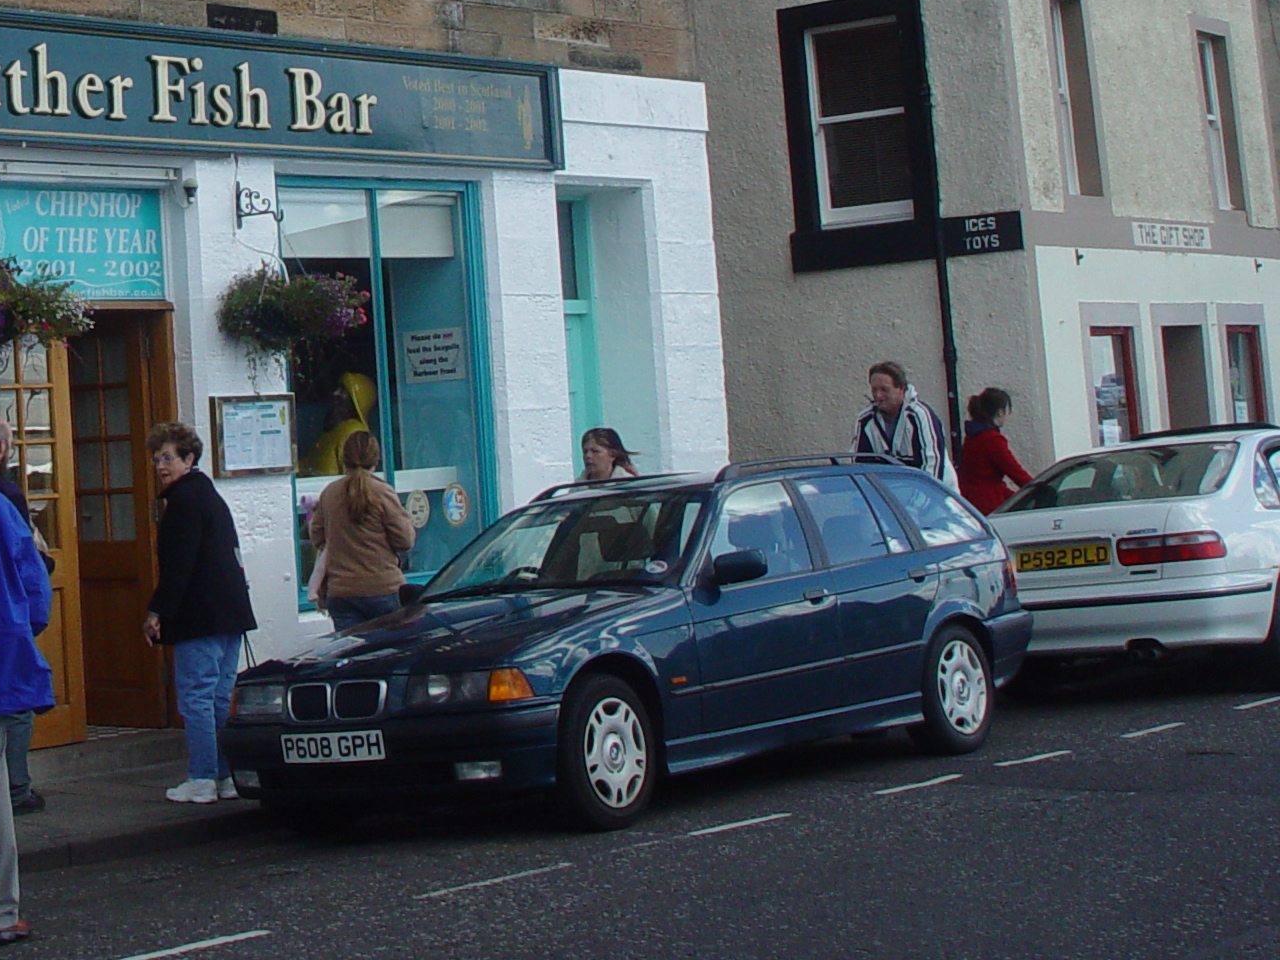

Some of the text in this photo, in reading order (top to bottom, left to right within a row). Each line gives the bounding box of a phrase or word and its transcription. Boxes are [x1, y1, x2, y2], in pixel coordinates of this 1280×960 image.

[149, 54, 272, 131] Fish
[287, 66, 379, 135] Bar
[434, 79, 455, 95] Best
[470, 82, 512, 98] Scotland
[35, 191, 142, 218] CHIPSHOP
[965, 216, 996, 232] ICES
[23, 226, 158, 254] OF THE YEAR
[963, 234, 1000, 250] TOYS
[1138, 224, 1205, 247] THE GIFT SHOP
[20, 259, 76, 277] 2001
[104, 260, 162, 278] 2002
[1019, 546, 1109, 568] P592 PLD
[283, 733, 382, 759] P608 GPH
